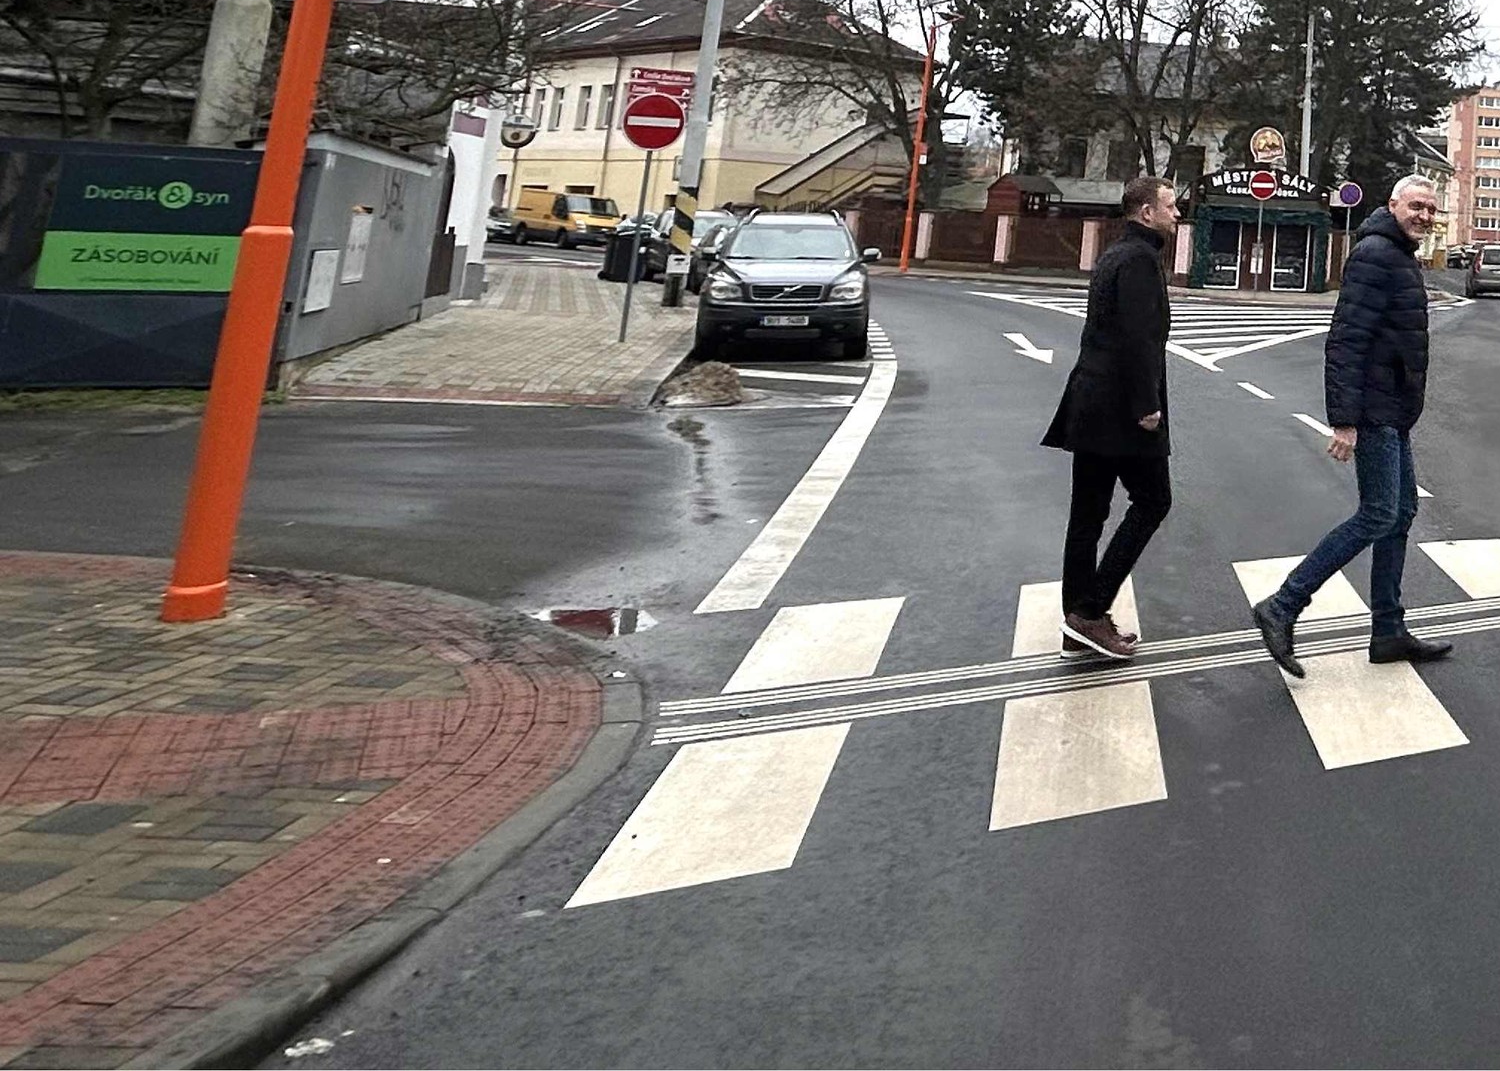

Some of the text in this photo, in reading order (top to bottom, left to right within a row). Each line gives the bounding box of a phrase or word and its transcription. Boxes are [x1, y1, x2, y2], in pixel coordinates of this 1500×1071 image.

[1281, 173, 1316, 193] SÁLY
[84, 184, 157, 201] Dvořák
[193, 190, 230, 206] syn
[71, 244, 222, 266] ZÁSOBOVÁNÍ
